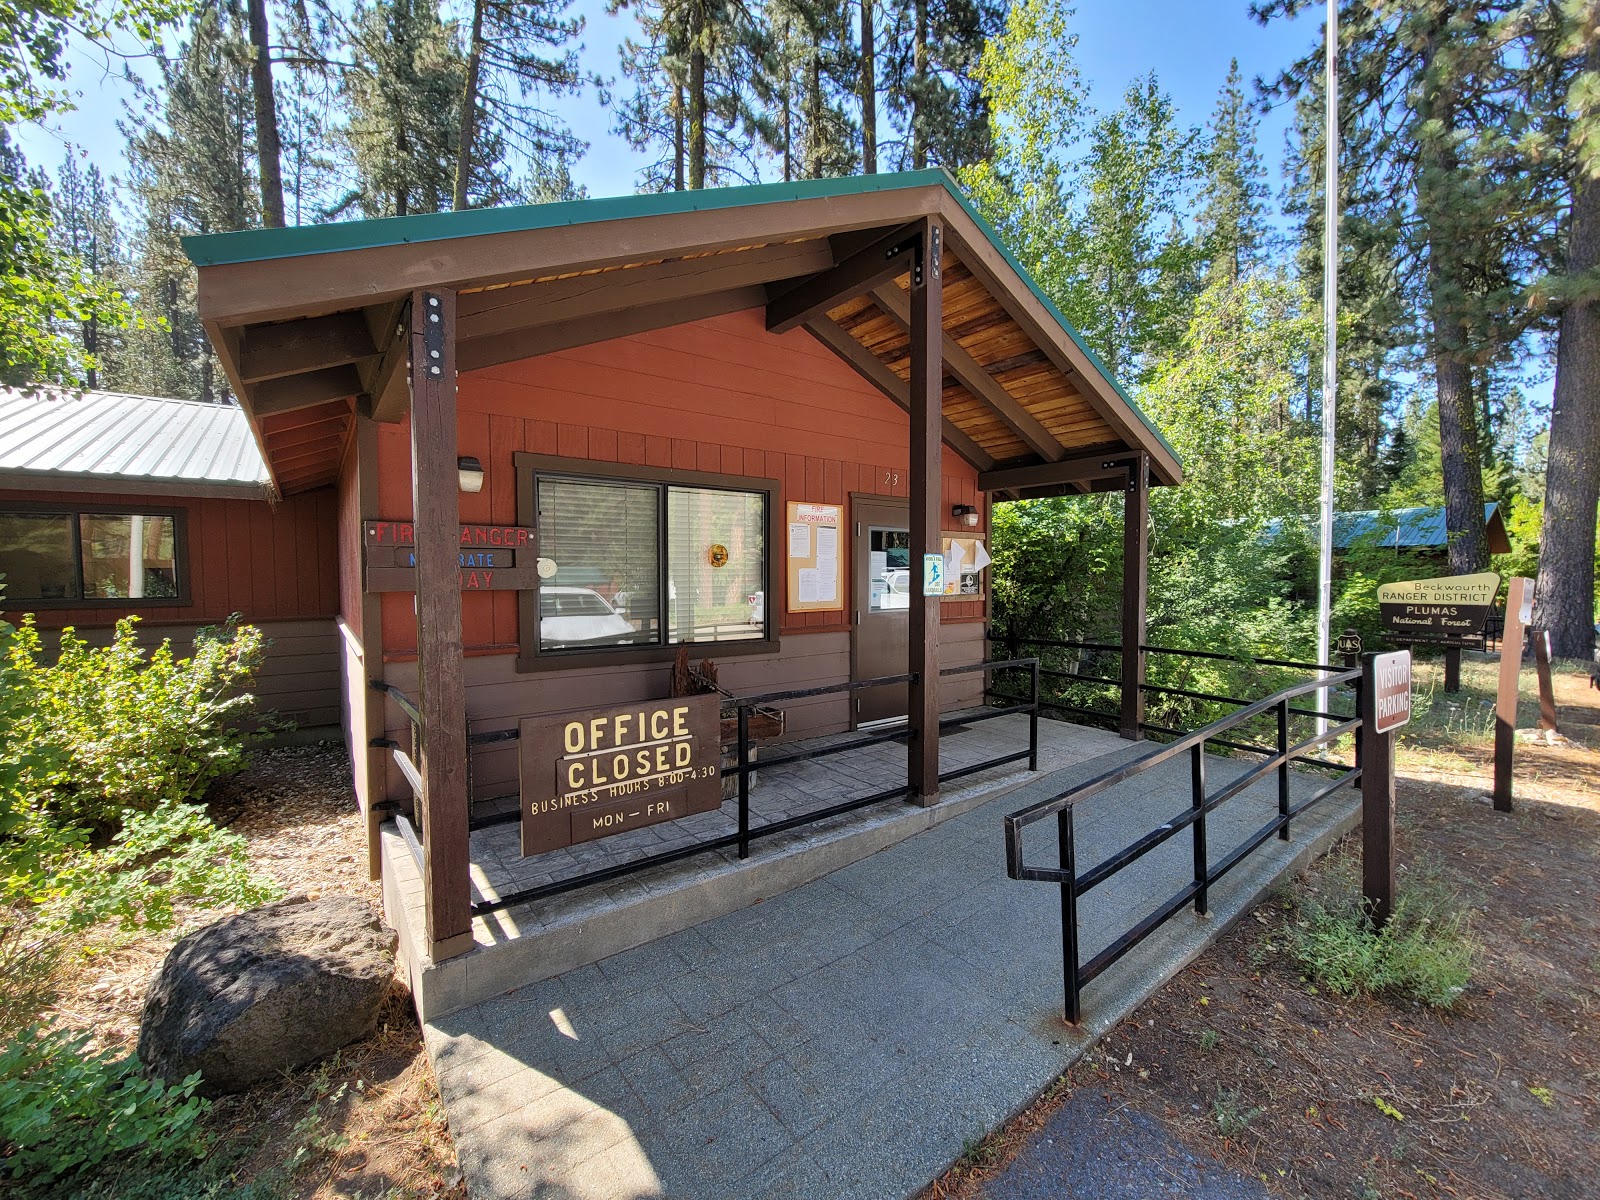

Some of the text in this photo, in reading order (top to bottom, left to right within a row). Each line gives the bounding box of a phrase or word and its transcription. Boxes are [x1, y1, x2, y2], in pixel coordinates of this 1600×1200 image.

[884, 472, 899, 486] 23
[811, 505, 825, 513] FIRE
[798, 514, 836, 523] INFORMATION
[376, 523, 528, 546] FIR ANGER
[1414, 583, 1491, 591] Beckwourth
[1382, 592, 1488, 602] RANGER DISTRICT
[1406, 606, 1458, 616] PLUMAS
[1392, 616, 1472, 627] National Forest
[1380, 664, 1407, 689] VISITOR
[1378, 690, 1409, 719] PARKING
[564, 706, 689, 753] OFFICE
[568, 742, 692, 789] CLOSED
[531, 790, 599, 816] BUSINESS
[609, 779, 650, 798] HOURS
[592, 811, 625, 830] MON
[647, 800, 670, 817] FRI
